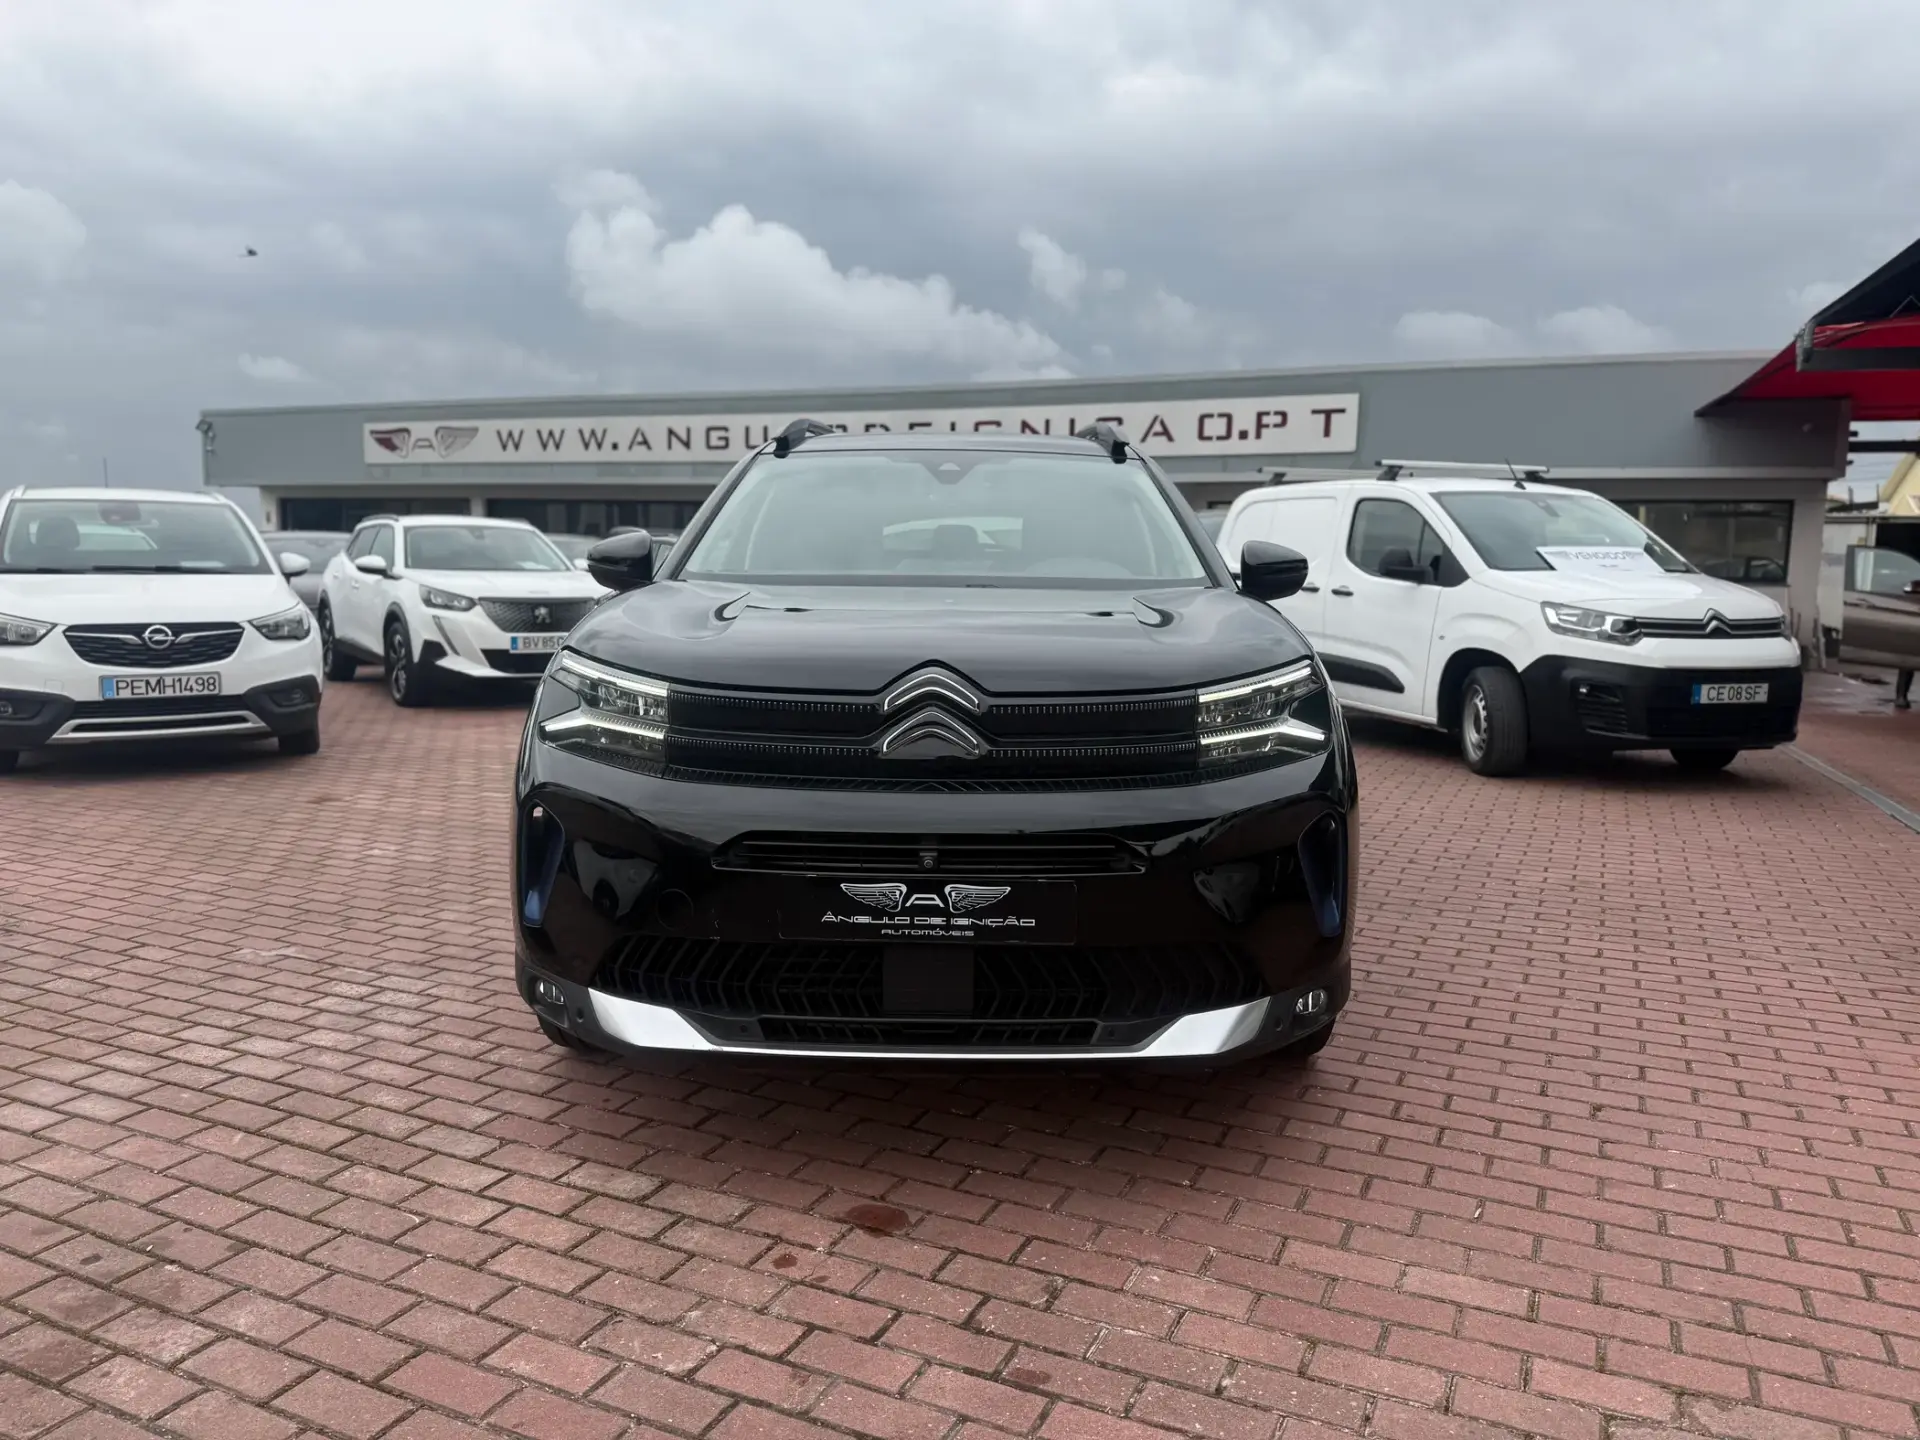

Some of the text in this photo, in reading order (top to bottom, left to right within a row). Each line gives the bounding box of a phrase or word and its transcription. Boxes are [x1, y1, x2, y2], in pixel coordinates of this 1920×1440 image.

[115, 676, 217, 696] PEMH1498
[821, 911, 1036, 927] ÂNGULO DE IGNIÇÃO
